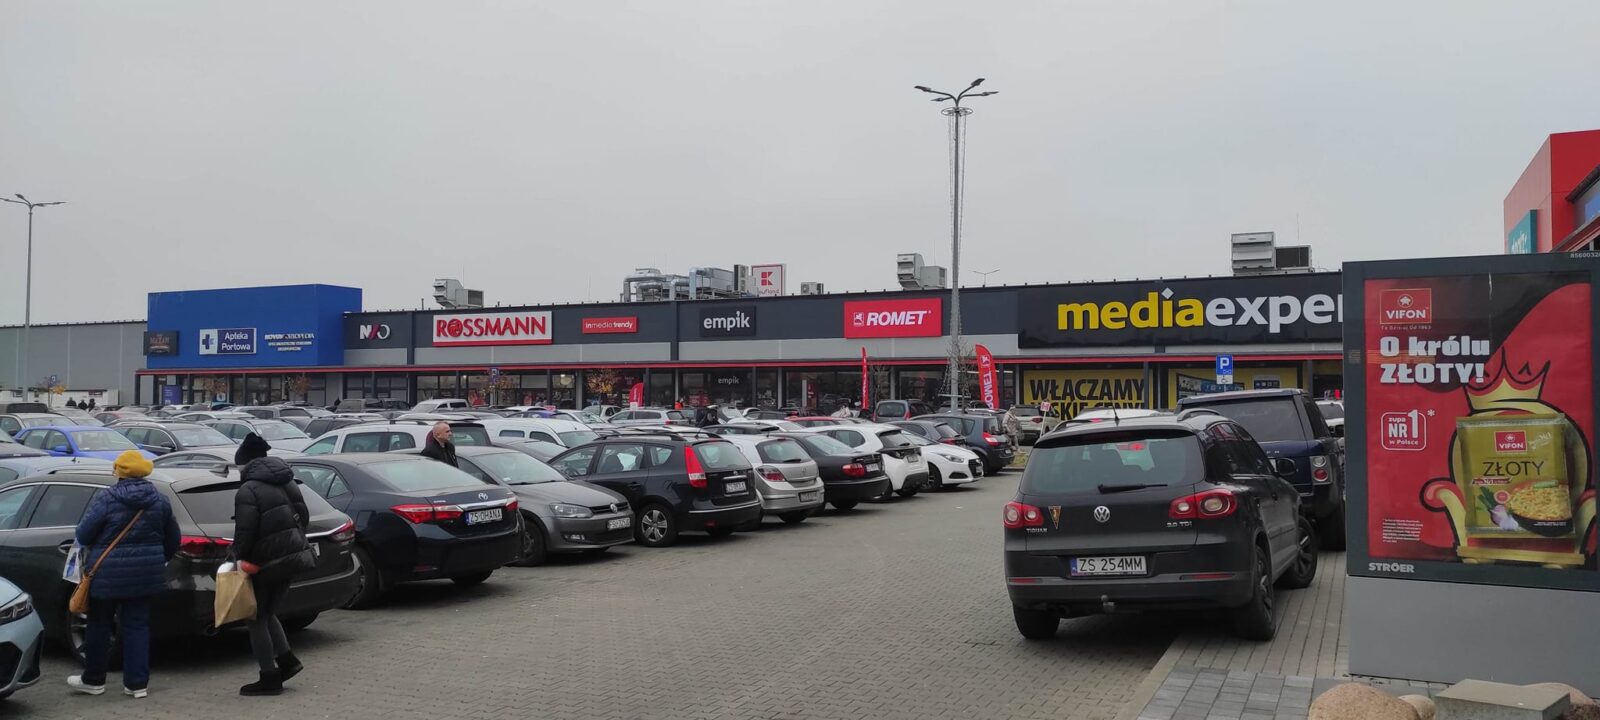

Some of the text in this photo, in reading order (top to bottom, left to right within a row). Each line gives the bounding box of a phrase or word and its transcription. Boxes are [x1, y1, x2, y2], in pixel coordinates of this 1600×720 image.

[703, 310, 750, 331] empik
[866, 310, 927, 326] ROMET
[1386, 309, 1426, 320] VIFON
[436, 316, 546, 337] ROSSMANN
[224, 332, 248, 341] Apteka
[221, 342, 251, 351] Portowa
[1380, 335, 1490, 357] O królu
[1220, 357, 1230, 370] P
[718, 376, 740, 386] empik
[1380, 363, 1485, 384] ZŁOTY!
[1388, 409, 1419, 439] NR 1
[1482, 461, 1545, 477] ZŁOTY
[1080, 557, 1143, 572] ZS 254MM
[1368, 562, 1415, 573] STRÖER
